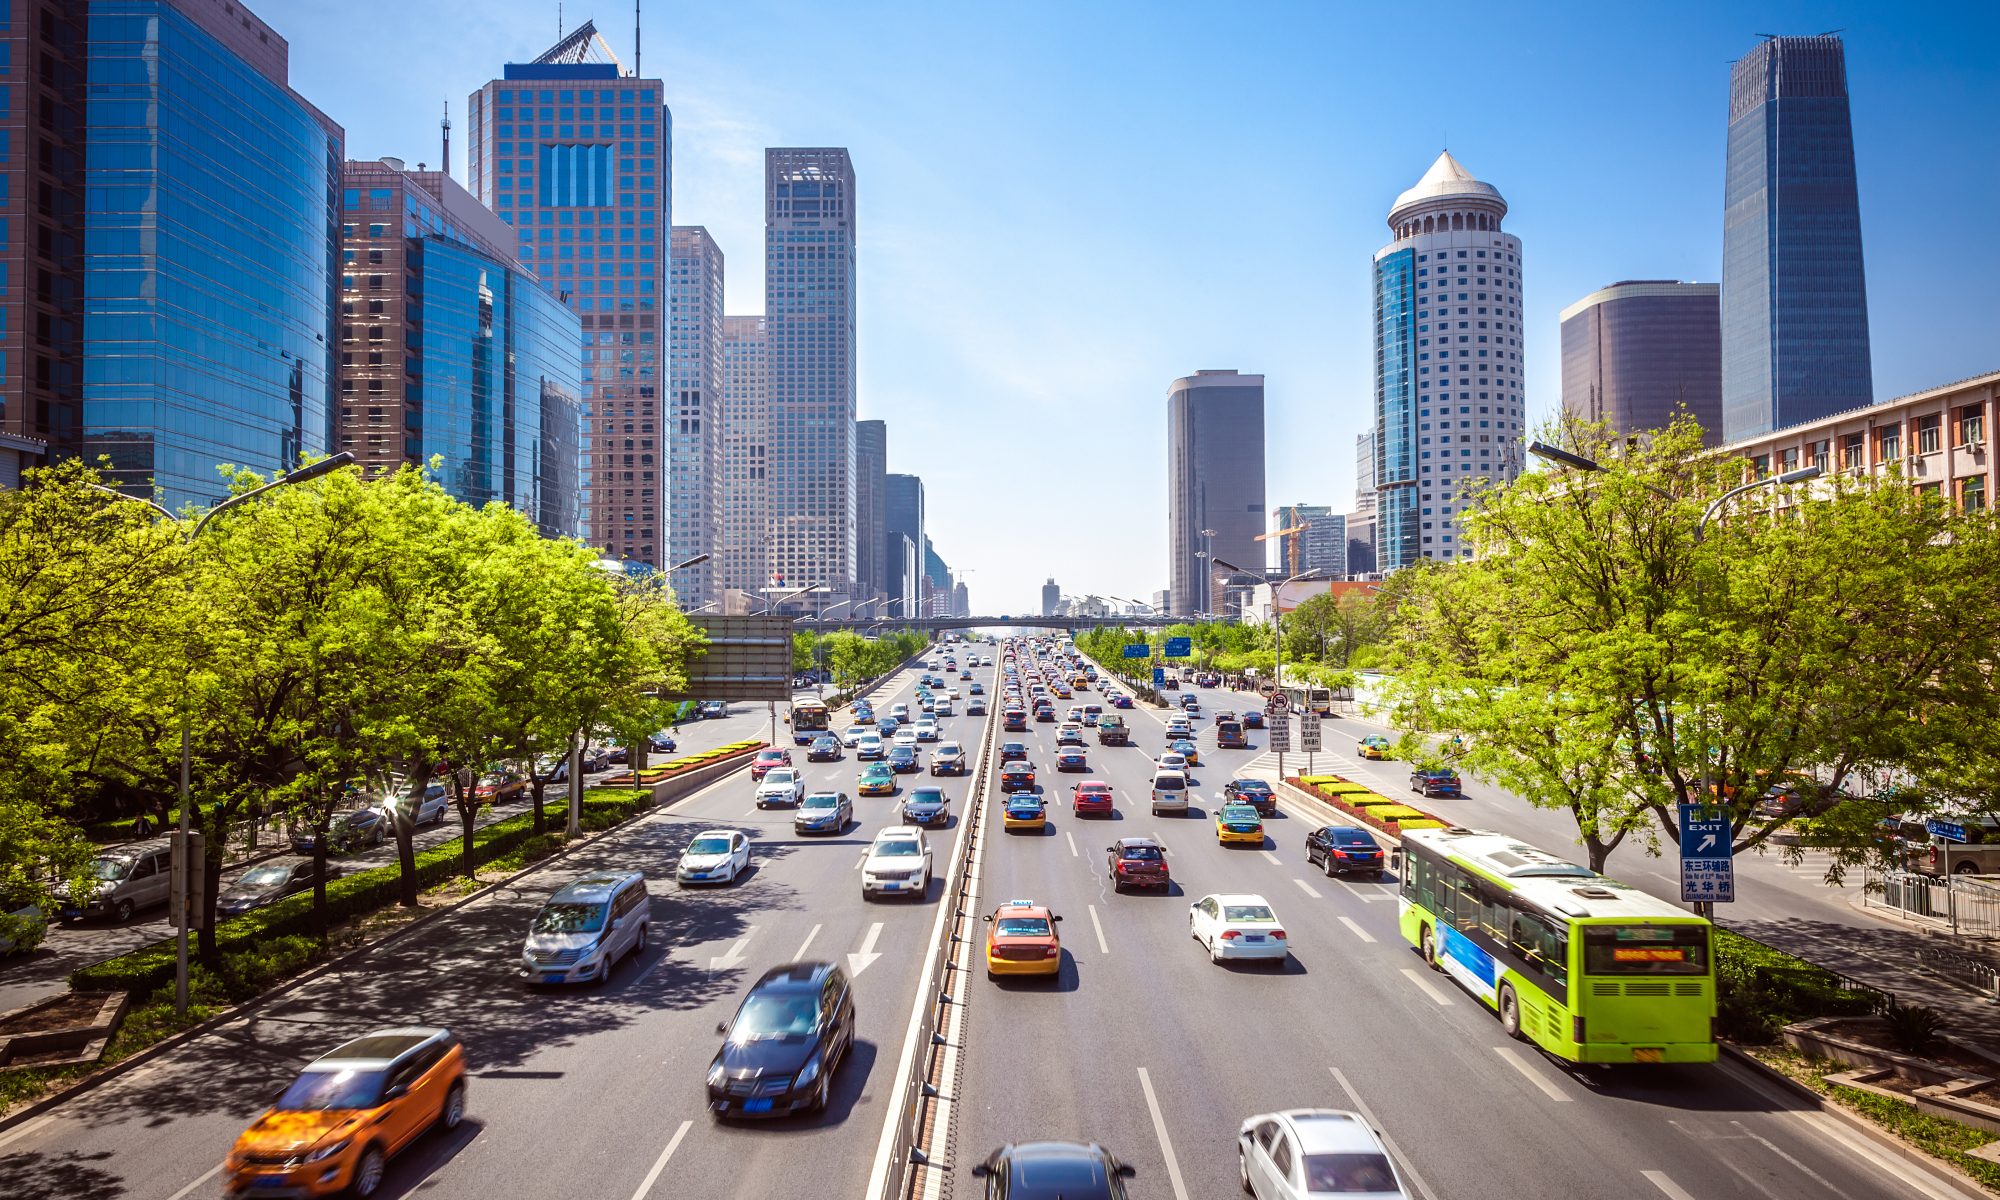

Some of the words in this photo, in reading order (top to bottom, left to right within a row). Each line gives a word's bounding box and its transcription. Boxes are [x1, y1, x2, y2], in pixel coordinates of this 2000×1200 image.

[1684, 860, 1730, 872] 东三环辅路
[1685, 881, 1731, 893] 光华桥
